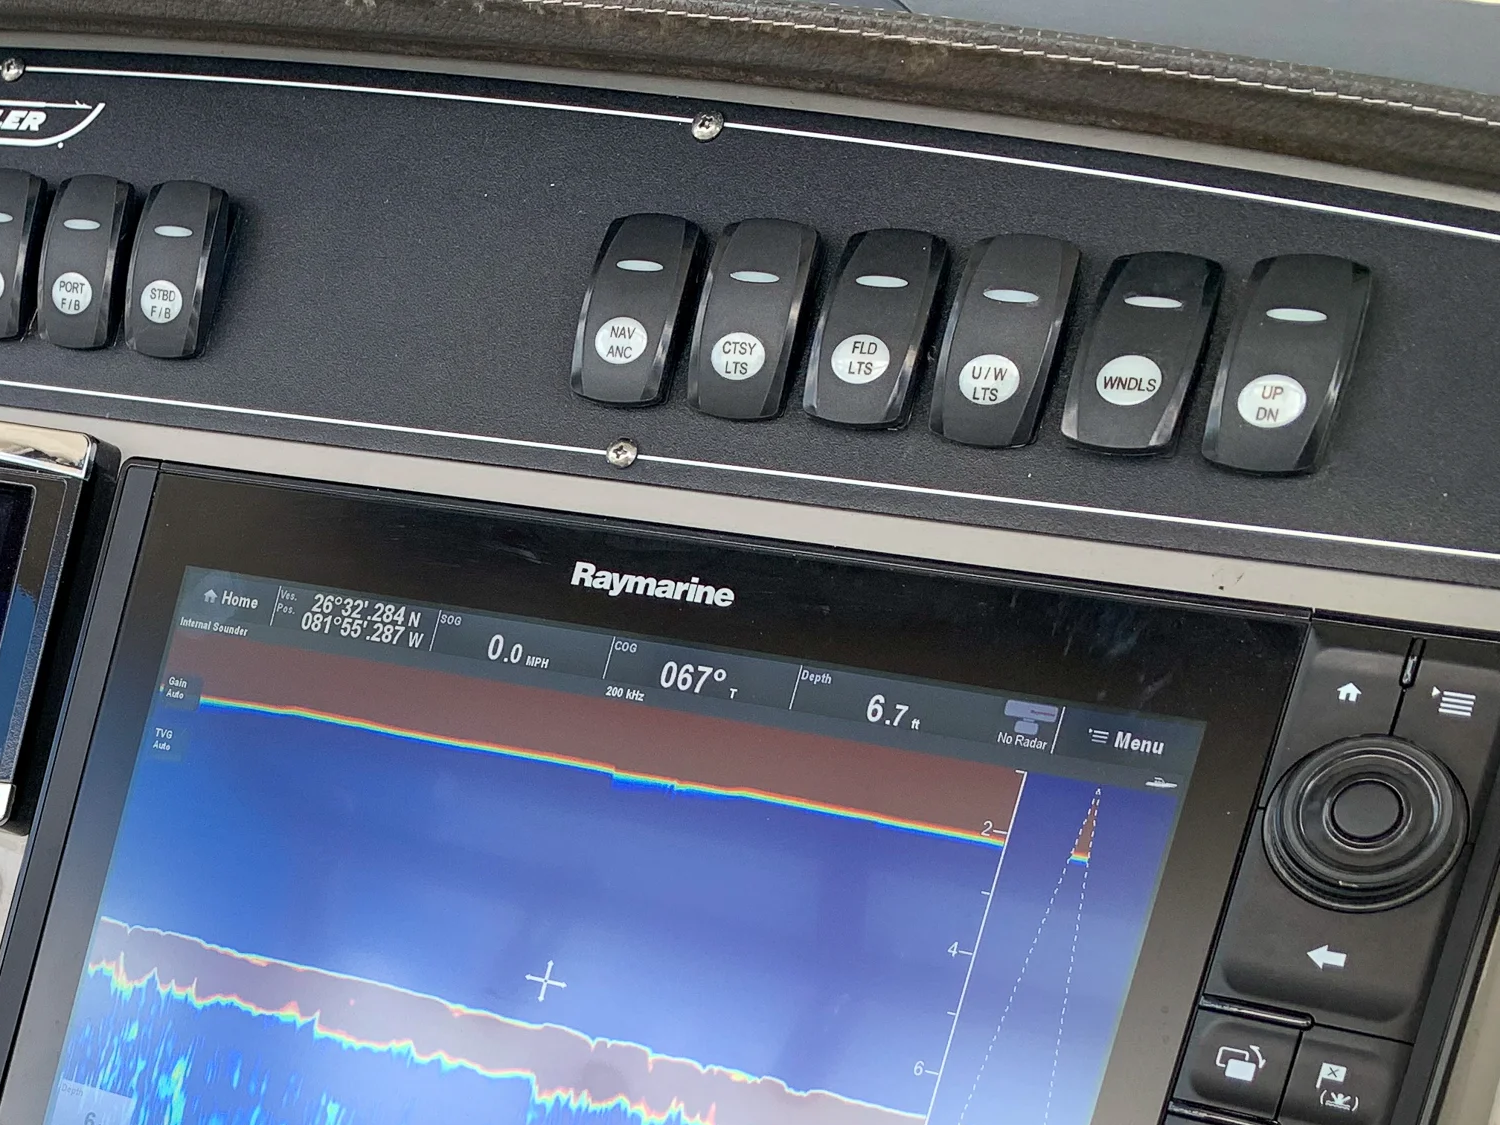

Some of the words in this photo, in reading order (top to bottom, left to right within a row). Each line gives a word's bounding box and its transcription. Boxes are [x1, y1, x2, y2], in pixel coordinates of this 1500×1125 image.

[58, 280, 86, 295] PORT
[150, 288, 177, 302] STBD
[610, 325, 637, 341] NAV
[606, 346, 633, 360] ANC
[722, 341, 757, 356] CTSY
[852, 341, 878, 355] FLD
[724, 362, 749, 375] LTS
[848, 362, 874, 376] LTS
[1102, 375, 1157, 393] WNDLS
[972, 386, 999, 402] LTS
[1261, 385, 1285, 401] UP
[1255, 407, 1280, 423] DN
[569, 560, 736, 608] Raymarine
[221, 590, 259, 610] Home
[280, 590, 298, 602] Ves.
[276, 603, 296, 615] Pos.
[180, 616, 211, 632] Internal
[212, 622, 249, 638] Sounder
[408, 611, 422, 628] N
[440, 613, 463, 626] SOG
[408, 632, 425, 649] W
[614, 640, 638, 653] COG
[487, 634, 524, 664] 0.0
[525, 655, 550, 670] MPH
[168, 676, 188, 689] Gain
[659, 660, 727, 695] 067°
[729, 687, 738, 700] T
[801, 669, 832, 686] Depth
[165, 688, 185, 700] Auto
[605, 686, 624, 698] 200
[625, 689, 645, 702] kHz
[866, 693, 910, 728] 6.7
[910, 717, 921, 731] ft
[155, 727, 173, 739] TVG
[997, 731, 1013, 745] No
[1014, 734, 1048, 750] Radar
[152, 740, 171, 751] Auto
[1113, 731, 1165, 755] Menu
[980, 820, 994, 837] 2
[947, 941, 959, 956] 4
[913, 1060, 925, 1076] 6
[61, 1083, 84, 1097] Depth
